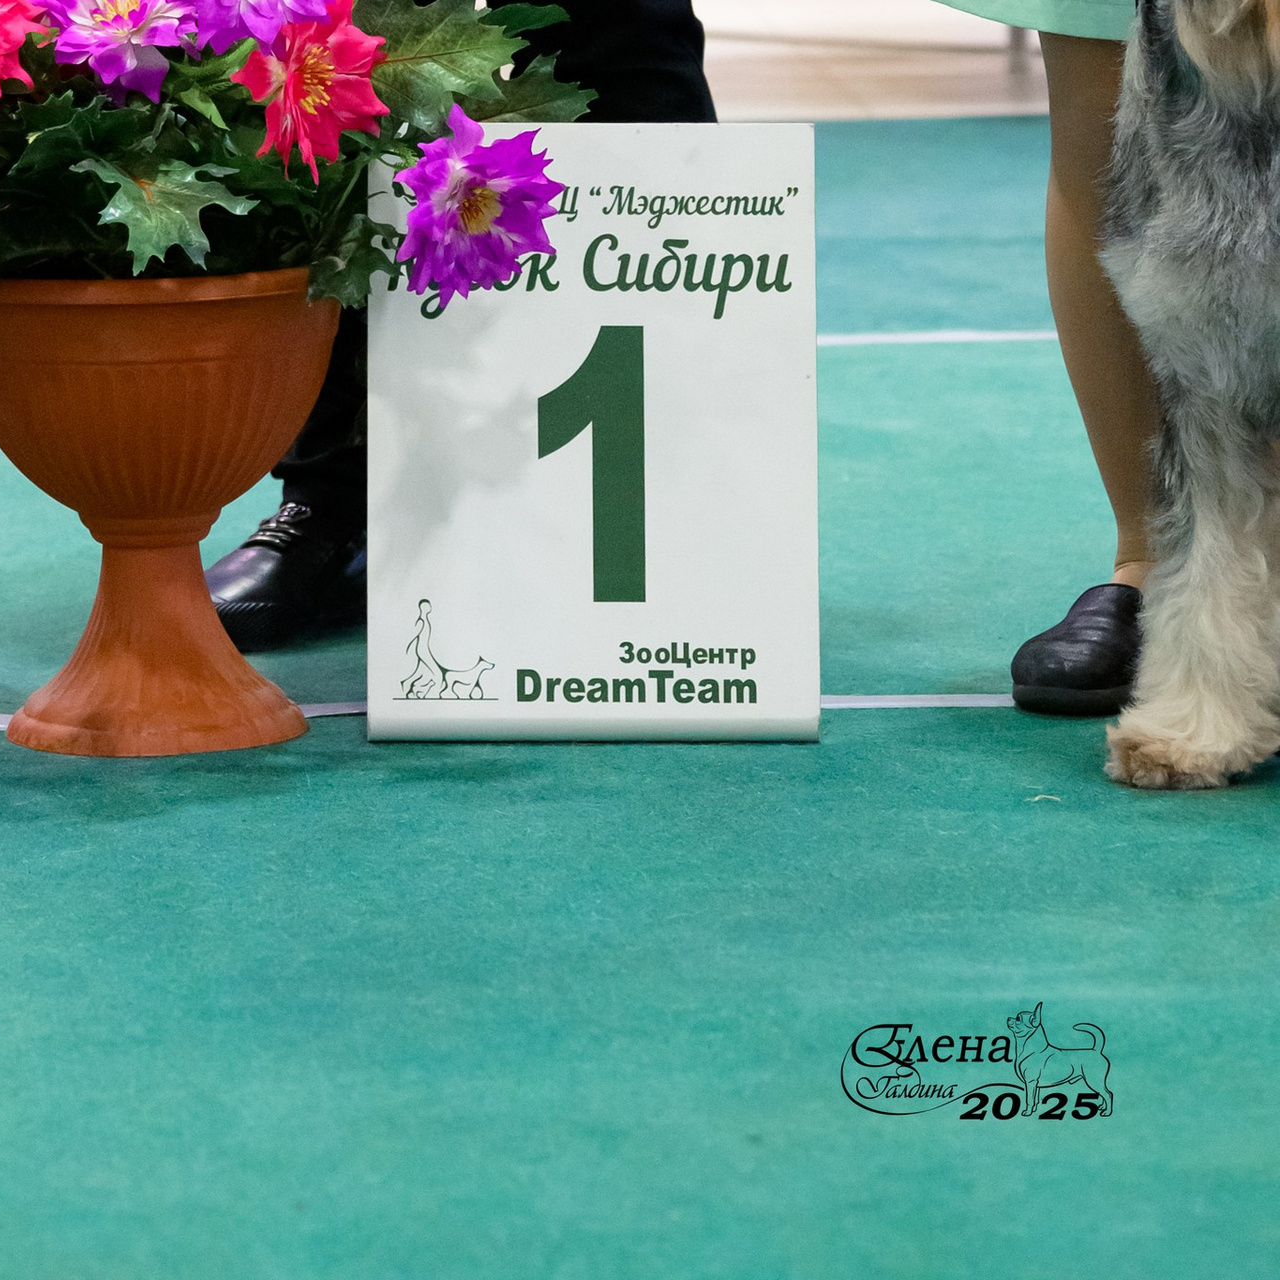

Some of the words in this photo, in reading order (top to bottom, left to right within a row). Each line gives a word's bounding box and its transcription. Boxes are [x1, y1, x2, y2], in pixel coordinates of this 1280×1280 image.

[582, 233, 793, 320] Сибири
[537, 324, 647, 603] 1
[516, 668, 758, 705] DreamTeam
[618, 641, 757, 670] ЗооЦентр
